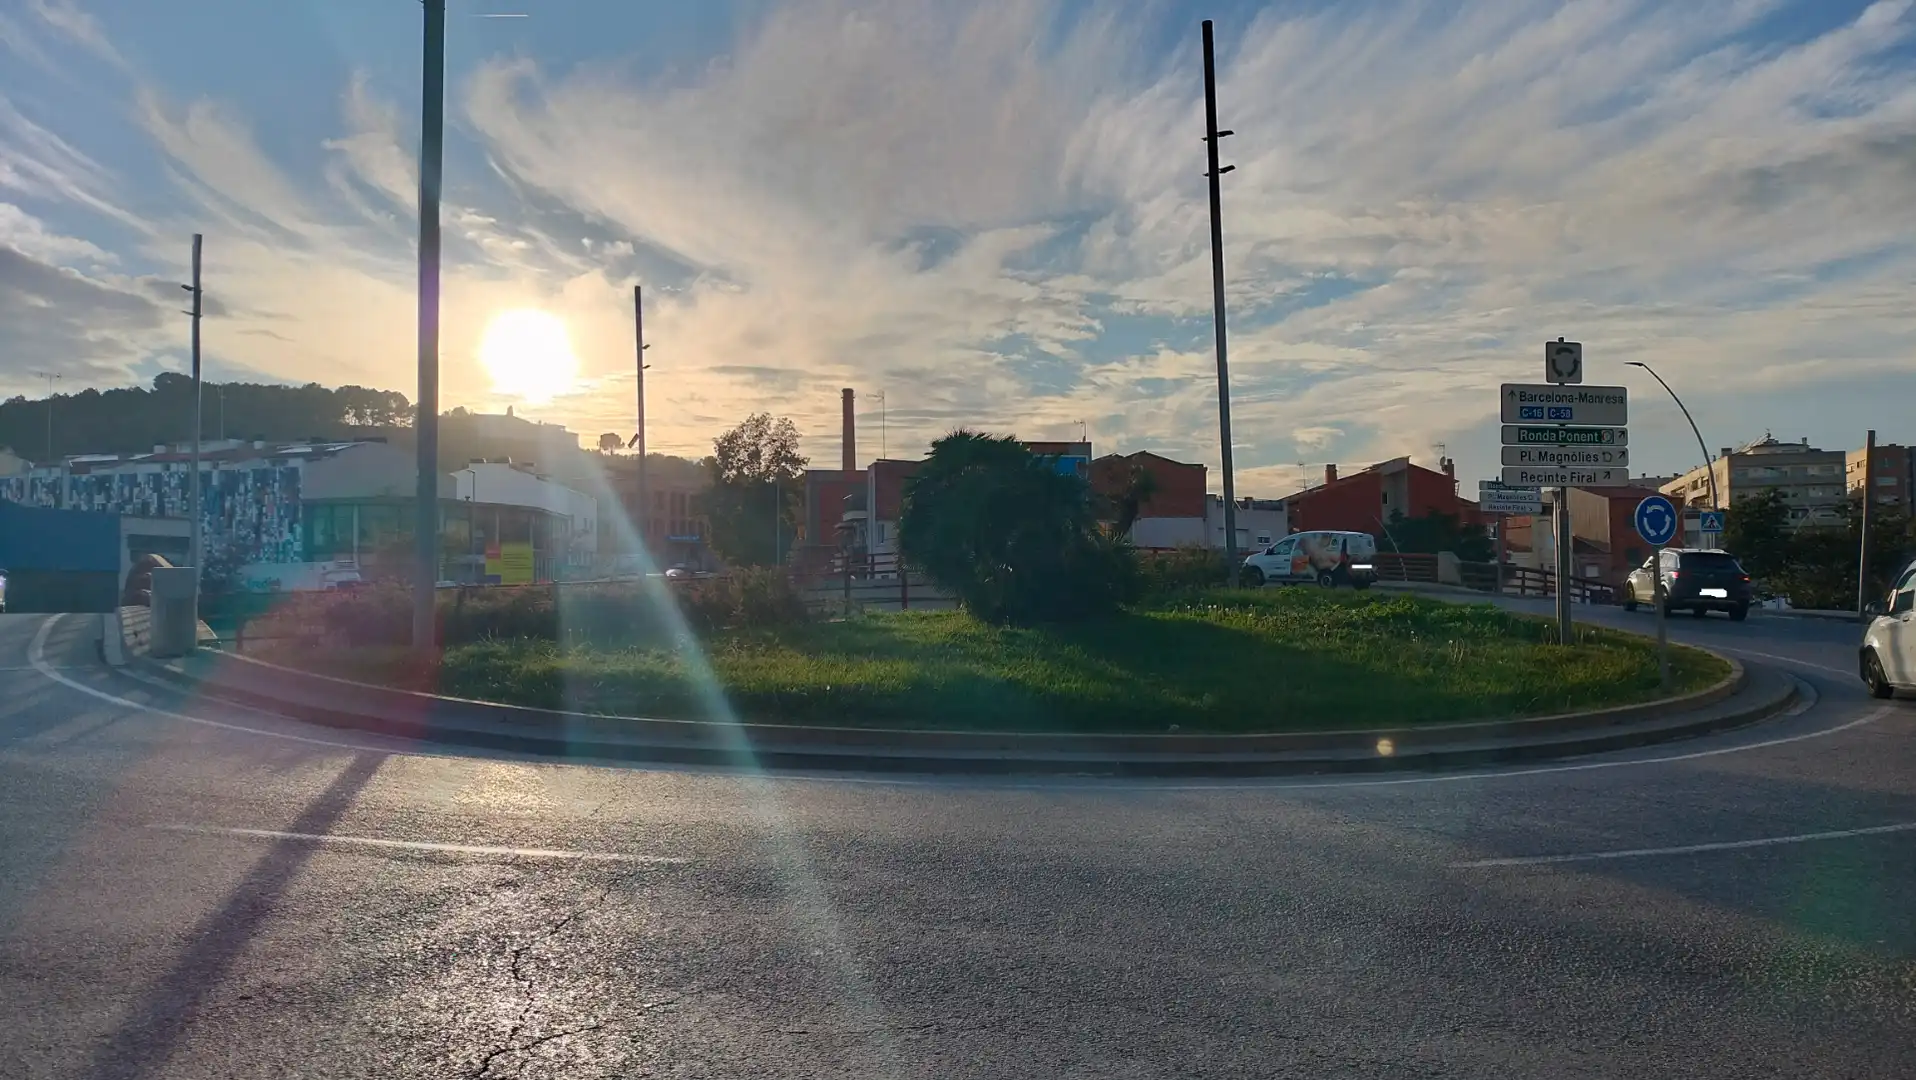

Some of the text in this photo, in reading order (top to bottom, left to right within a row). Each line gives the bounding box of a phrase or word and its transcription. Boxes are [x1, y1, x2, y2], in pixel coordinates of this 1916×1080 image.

[1519, 391, 1624, 404] Barcelona-Manresa
[1522, 408, 1571, 418] C-16 C-58
[1520, 430, 1599, 442] Ronda Ponent
[1520, 451, 1535, 462] Pl.
[1520, 472, 1597, 483] Recinte Firal
